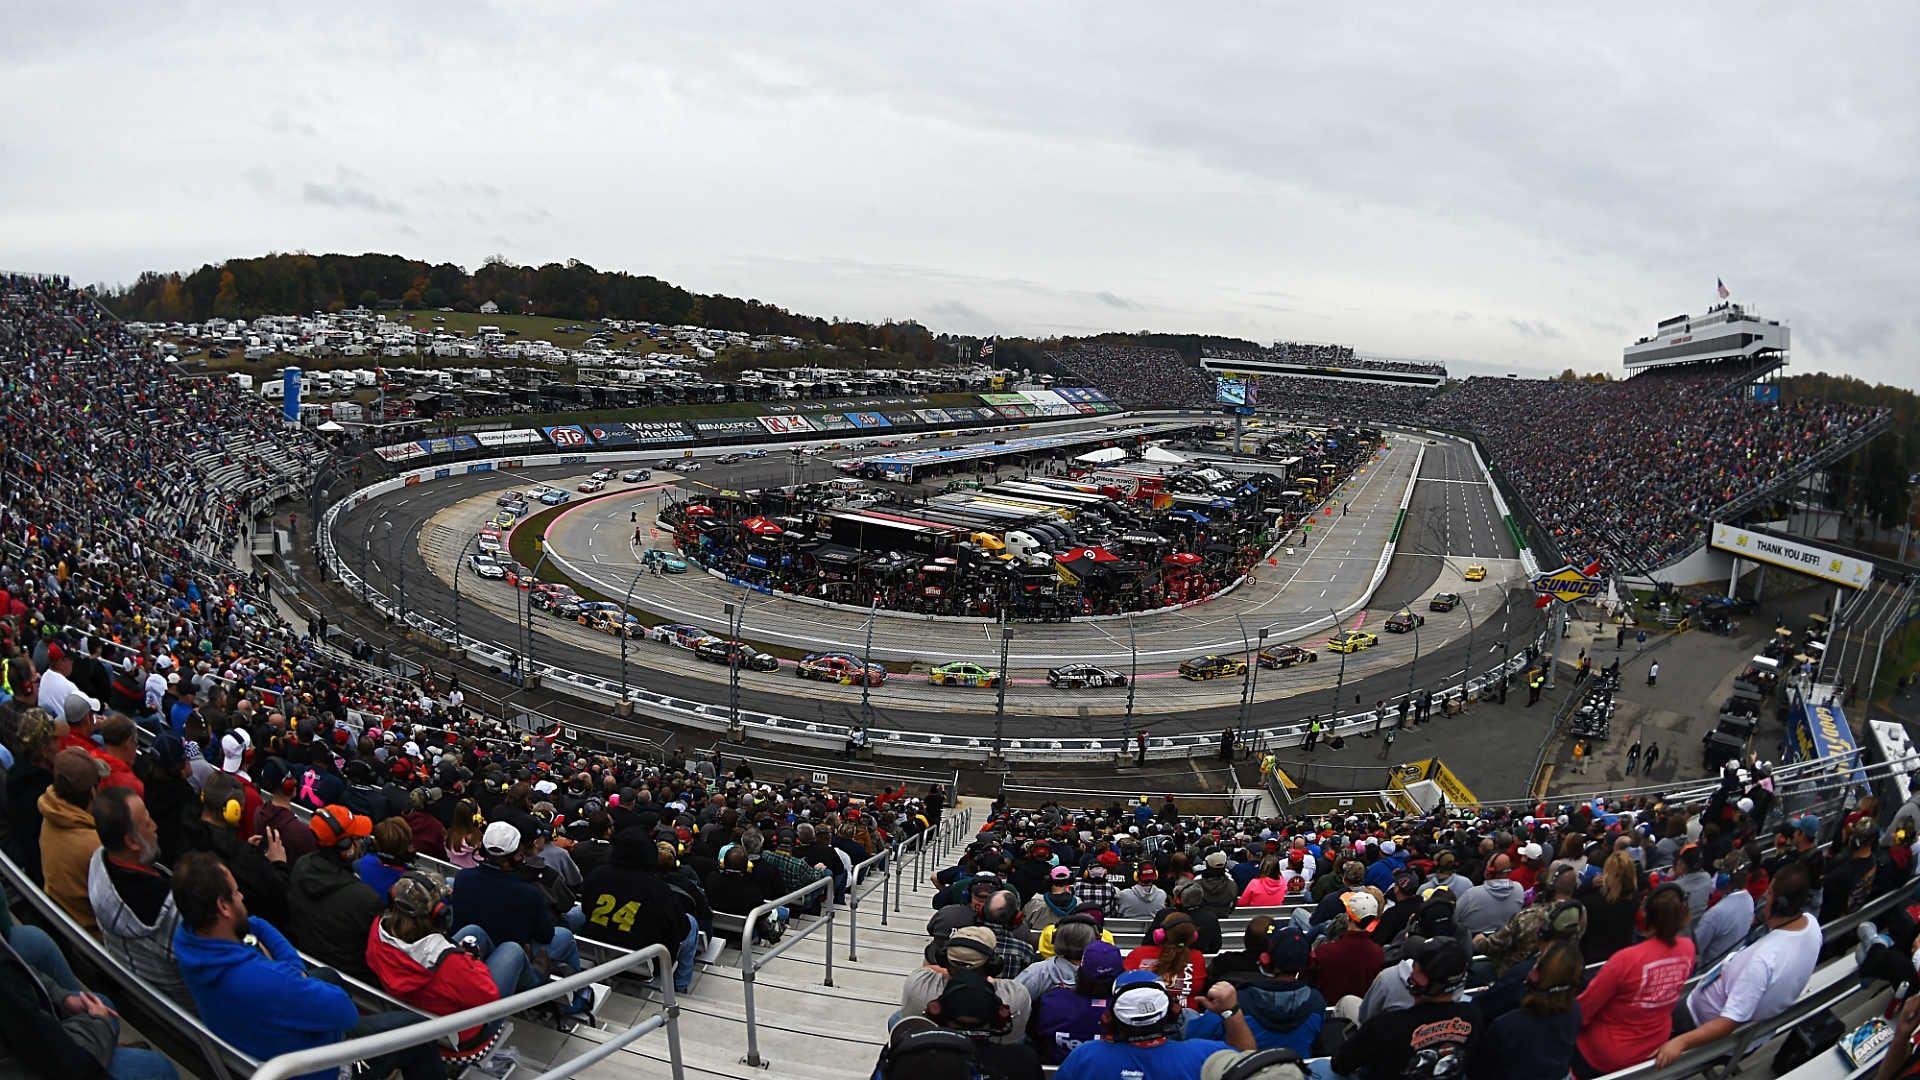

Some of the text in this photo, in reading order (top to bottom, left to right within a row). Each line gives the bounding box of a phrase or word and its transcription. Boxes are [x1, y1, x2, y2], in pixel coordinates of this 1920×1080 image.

[624, 421, 683, 431] Weaver
[637, 428, 685, 438] Media
[708, 421, 757, 430] MAXPRO
[556, 429, 582, 444] STP
[1757, 540, 1820, 566] THANK YOU JEFF!
[1540, 577, 1600, 595] SUNOCO
[590, 893, 642, 932] 24
